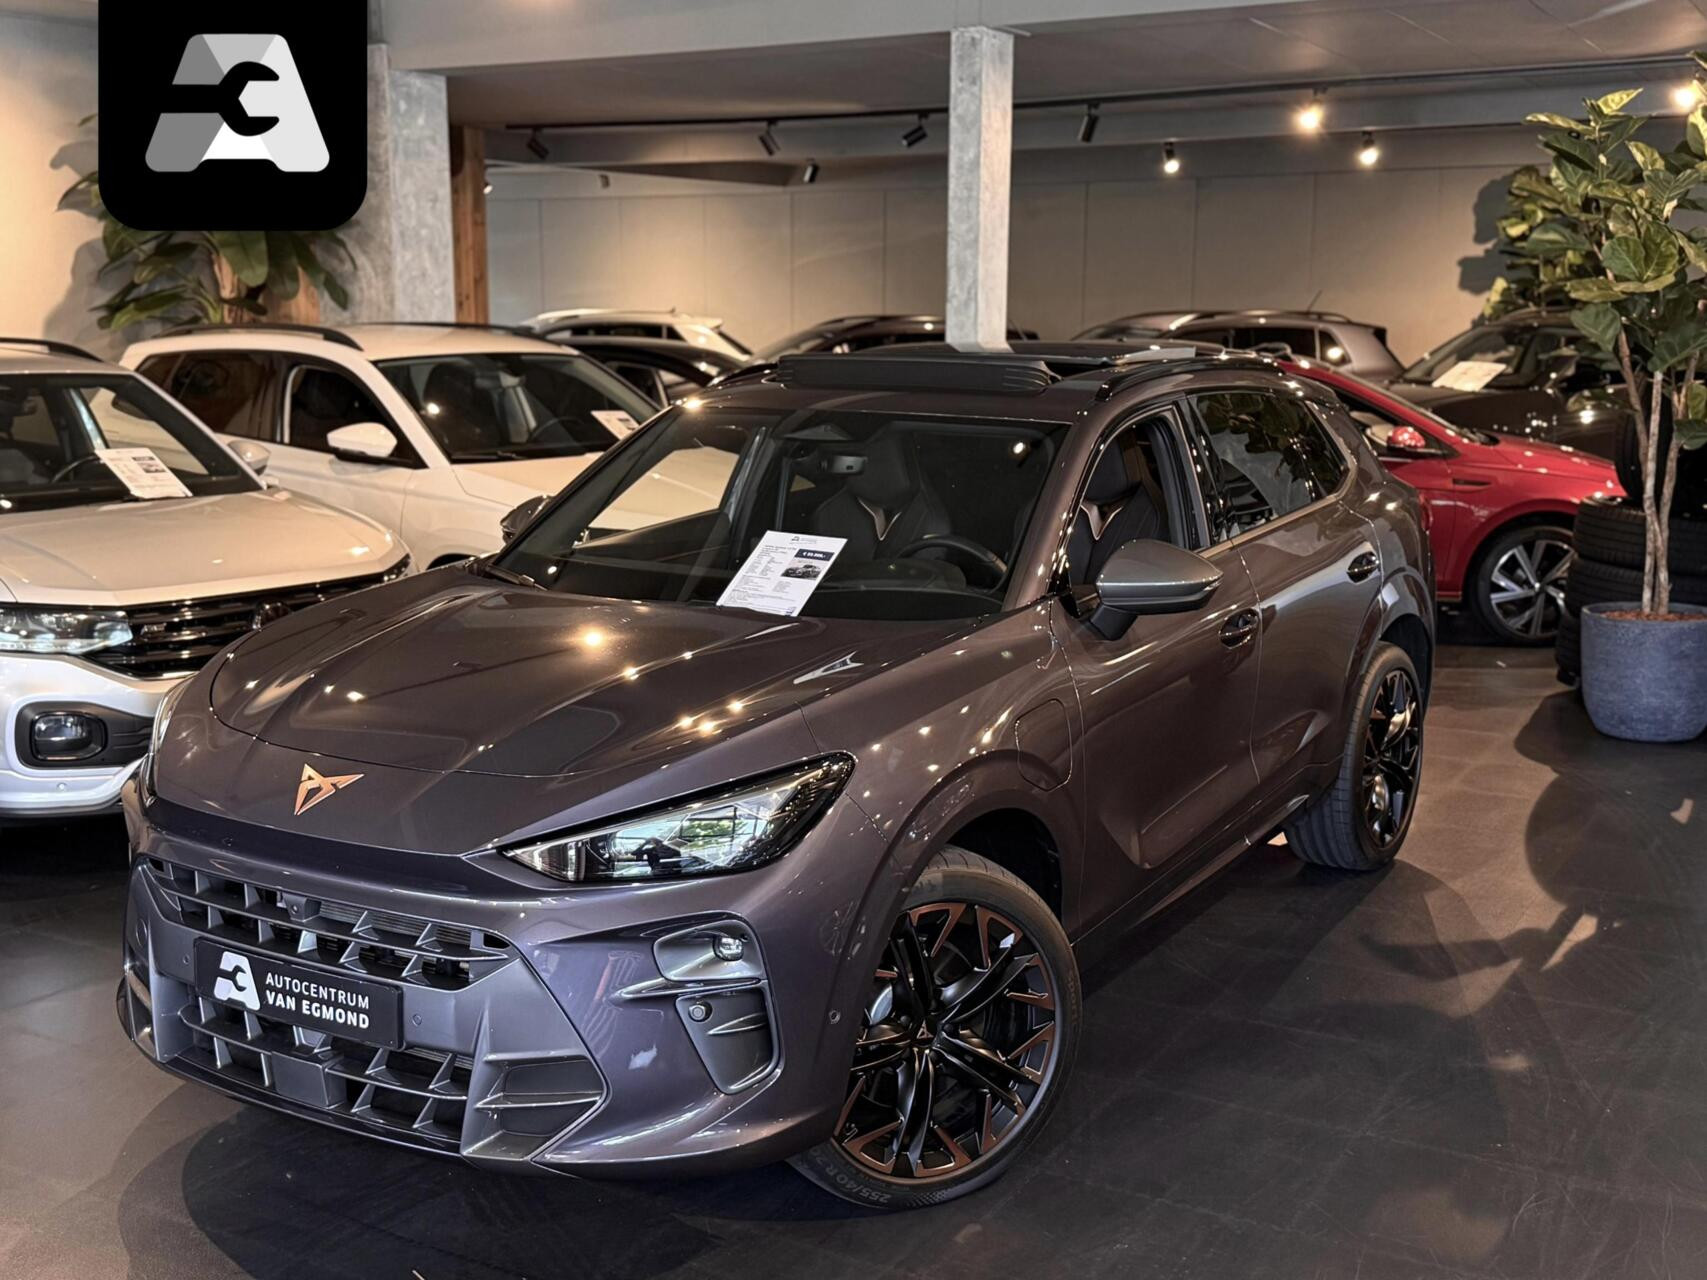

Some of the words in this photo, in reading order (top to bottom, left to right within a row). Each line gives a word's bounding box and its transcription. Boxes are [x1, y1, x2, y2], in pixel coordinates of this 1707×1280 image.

[265, 972, 369, 1009] AUTOCENTRUM
[266, 990, 296, 1011] VAN
[302, 1000, 370, 1029] EGMOND
